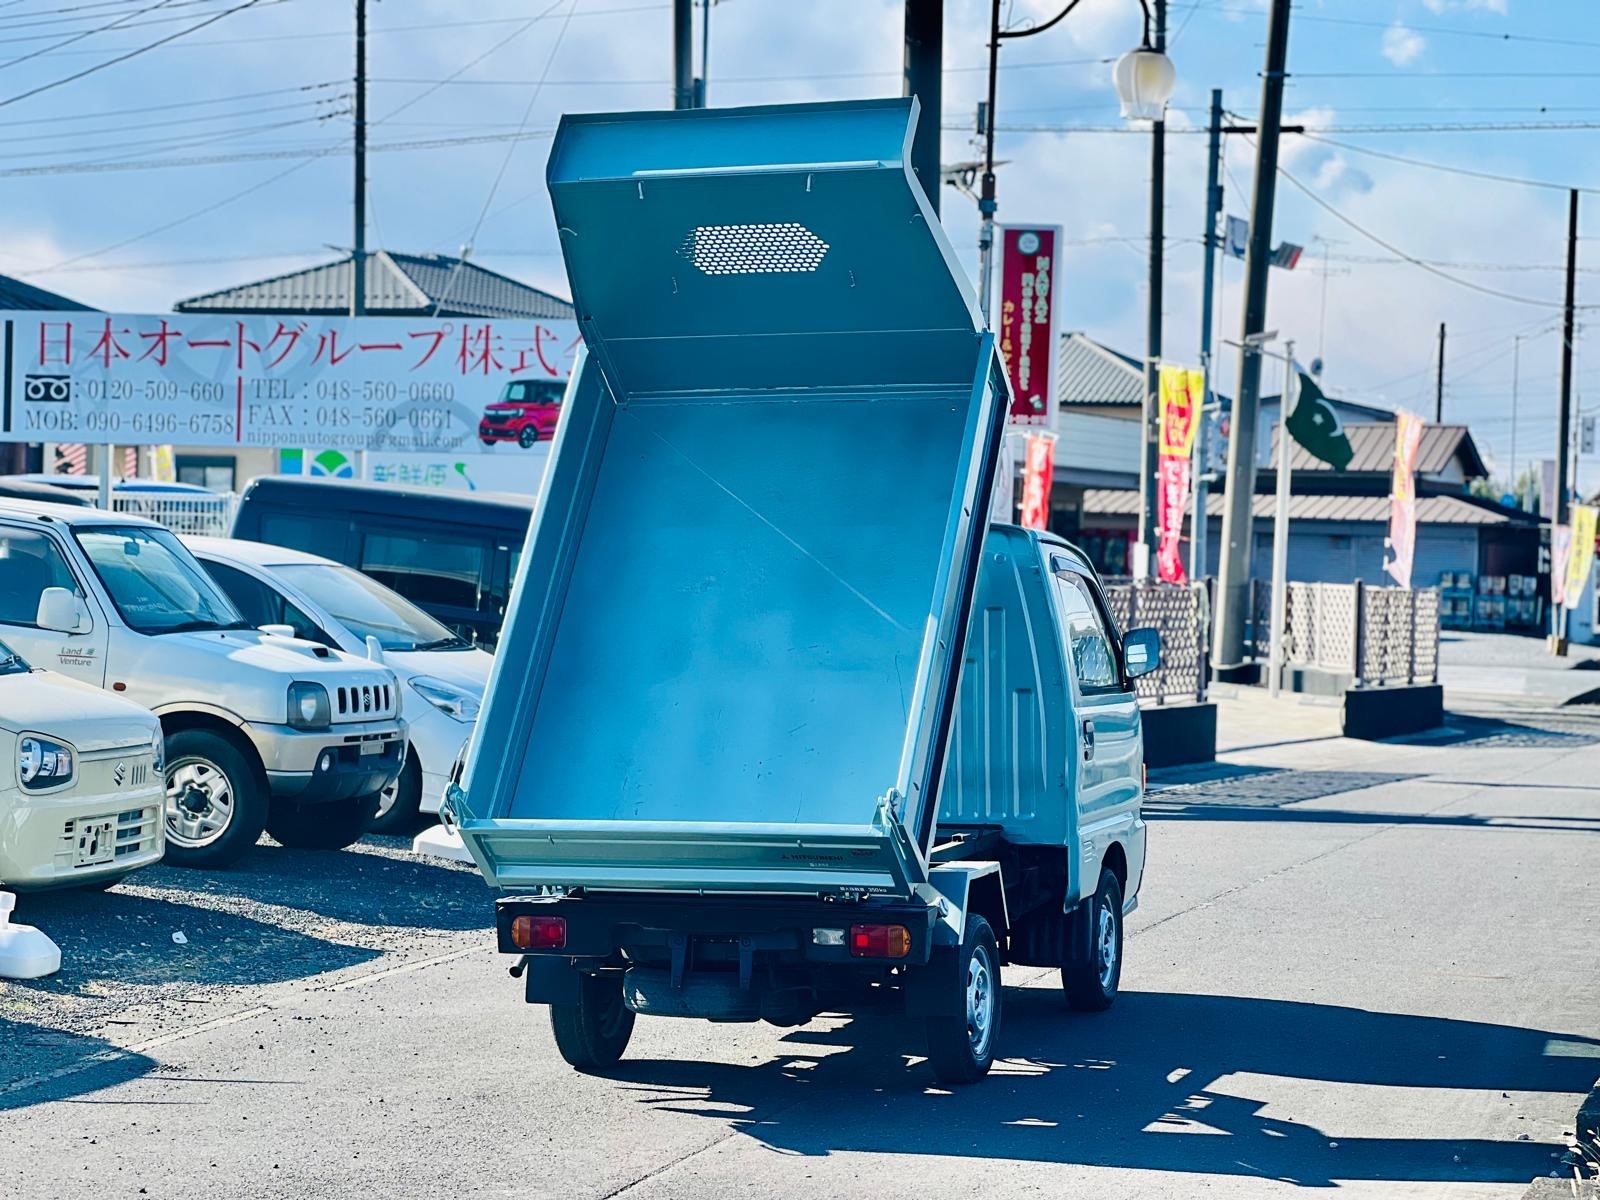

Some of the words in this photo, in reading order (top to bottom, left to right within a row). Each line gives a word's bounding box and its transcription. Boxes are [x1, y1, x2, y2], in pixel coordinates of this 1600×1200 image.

[87, 379, 225, 401] 0120-509-660
[251, 378, 295, 400] TEL
[316, 380, 454, 402] 048-560-0660
[86, 411, 235, 435] 090-6496-6758
[249, 404, 294, 426] FAX
[316, 406, 452, 430] 048-560-0661
[60, 656, 92, 667] Venture
[61, 646, 83, 656] Land
